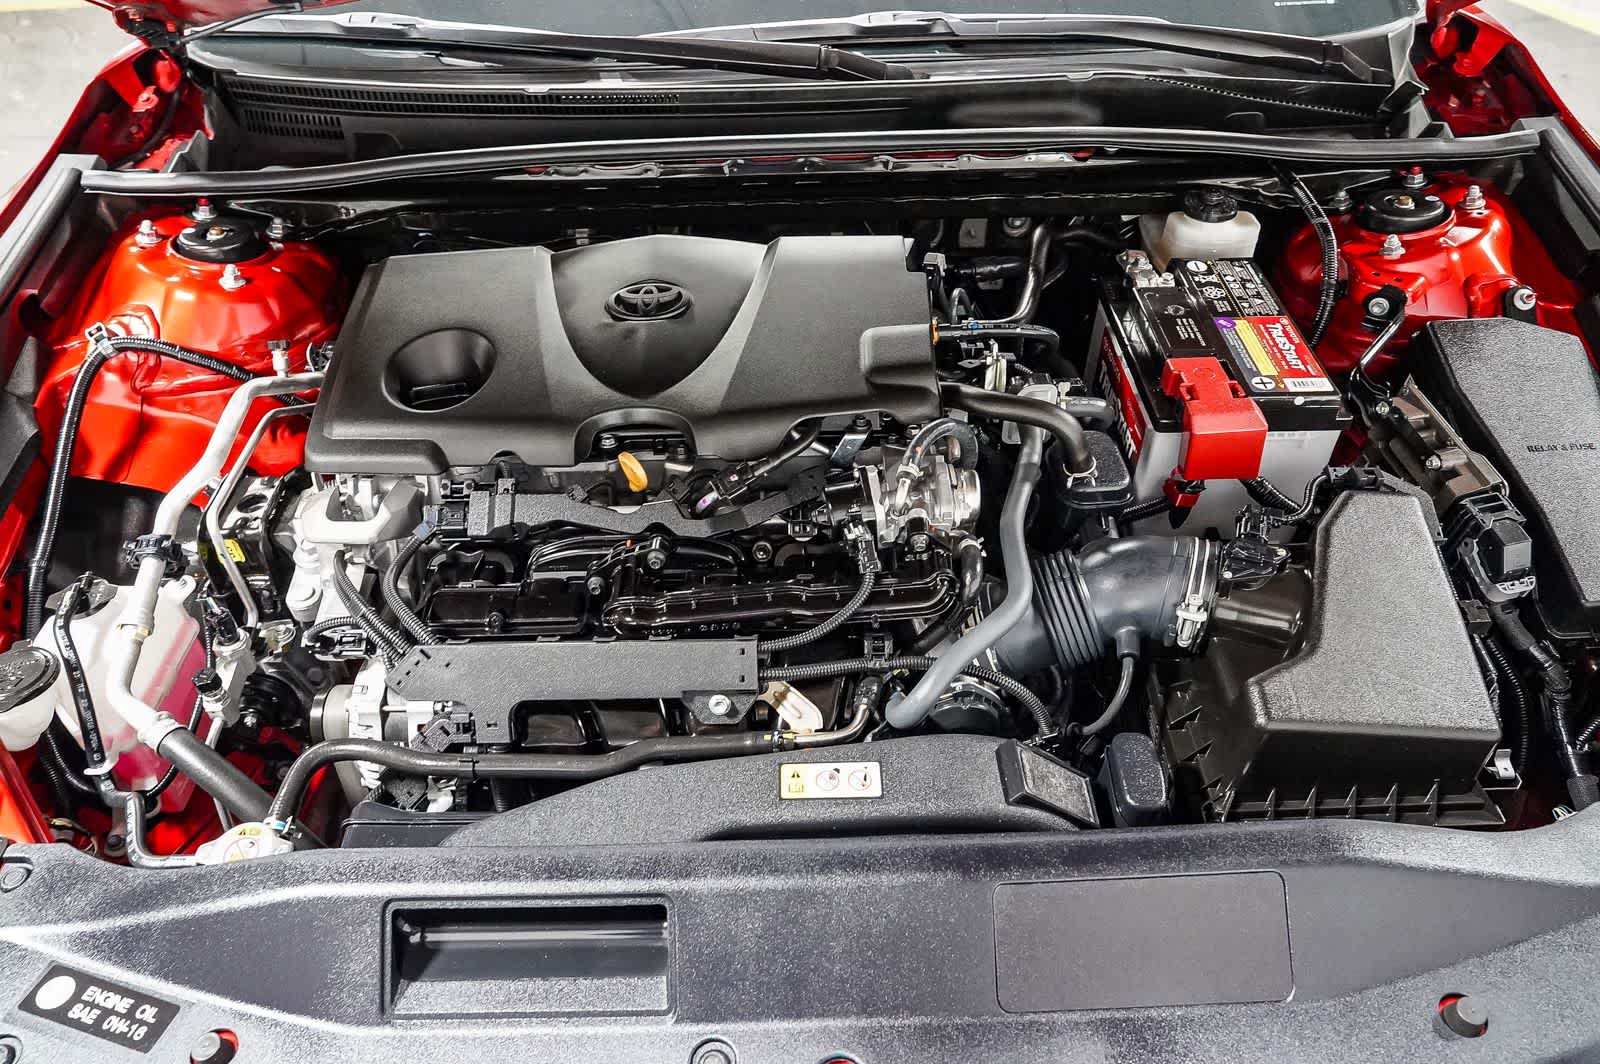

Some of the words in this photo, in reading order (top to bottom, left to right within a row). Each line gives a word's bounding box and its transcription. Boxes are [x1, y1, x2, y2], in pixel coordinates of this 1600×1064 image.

[1285, 323, 1300, 344] TOYOTA
[1526, 444, 1560, 453] RELAY
[1569, 442, 1597, 451] FUSE
[81, 985, 135, 1014] ENGINE
[135, 1003, 160, 1024] OIL
[67, 1003, 101, 1025] SAE
[102, 1015, 148, 1041] 0W-16
